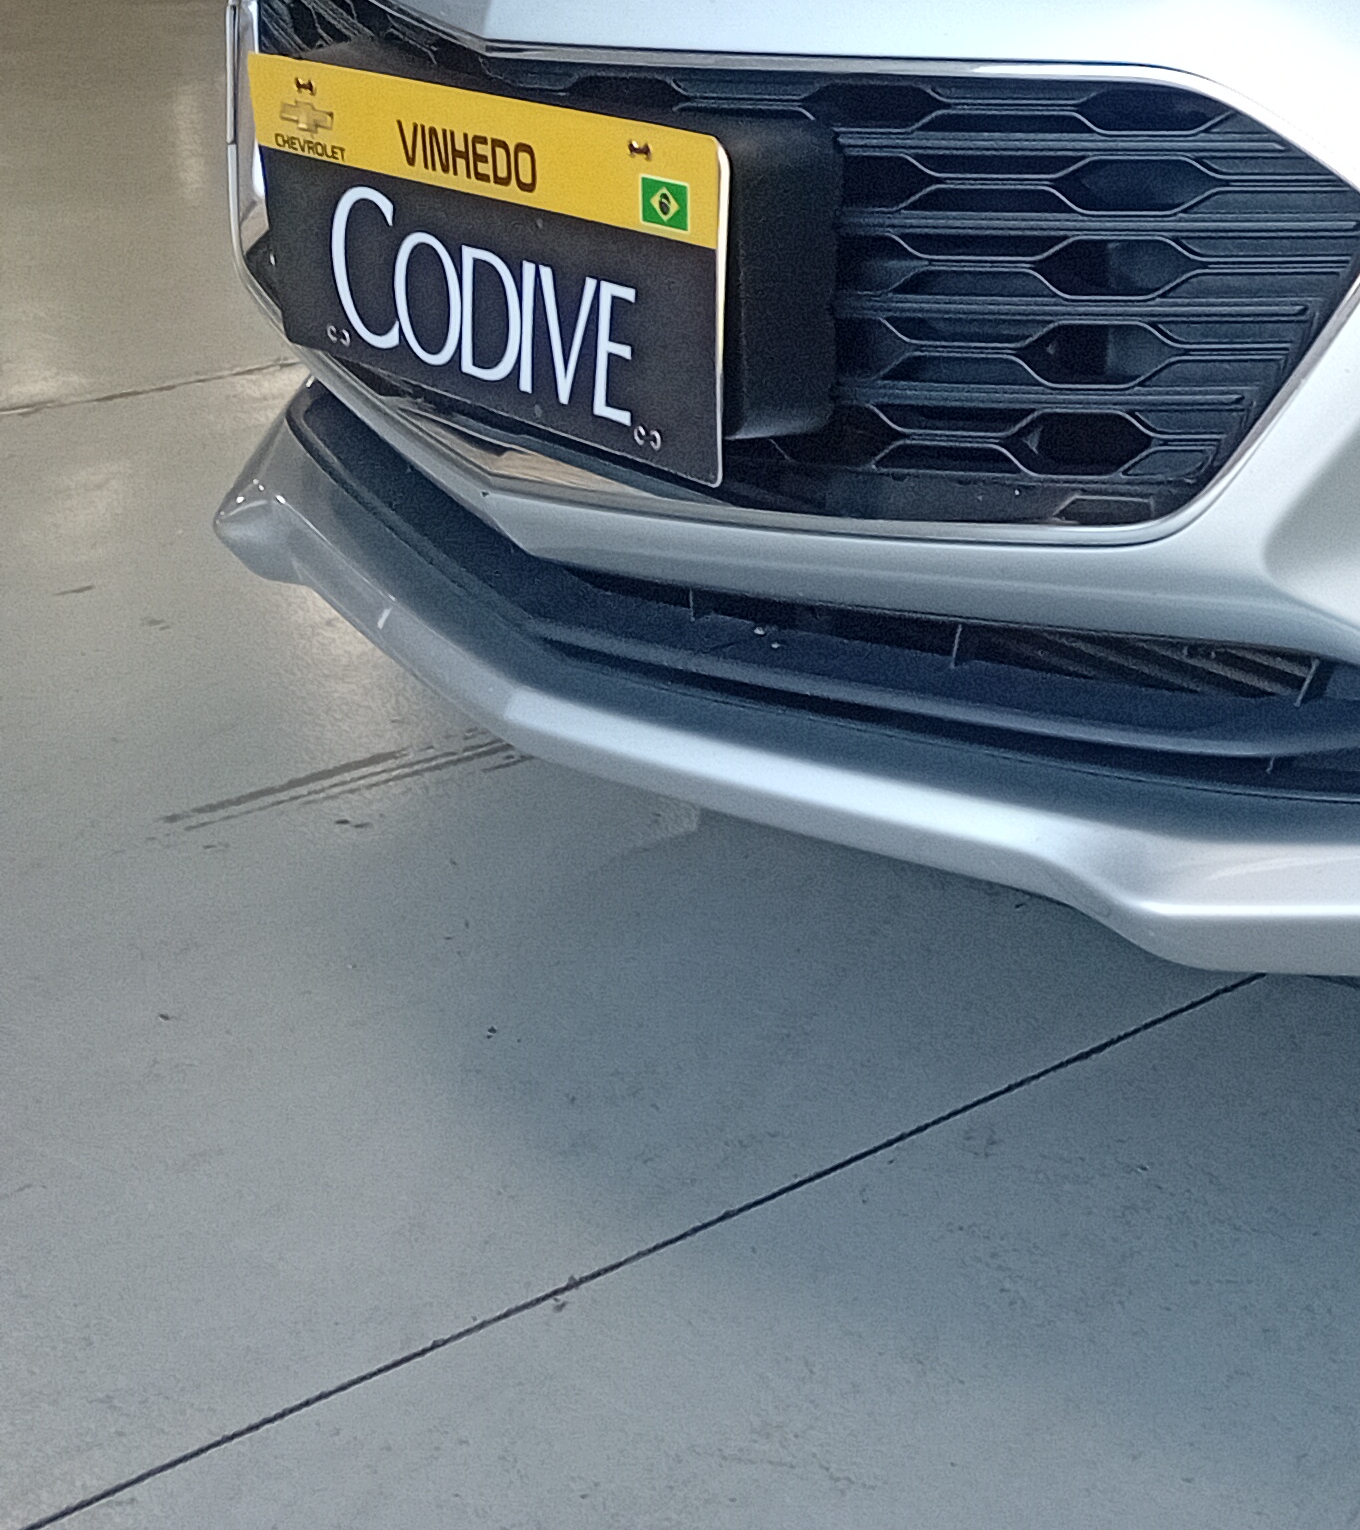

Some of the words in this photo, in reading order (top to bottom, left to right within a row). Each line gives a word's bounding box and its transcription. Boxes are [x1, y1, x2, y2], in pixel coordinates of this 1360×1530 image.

[274, 132, 347, 163] CHEVROLET
[396, 119, 538, 193] VINHEDO
[330, 185, 637, 427] CODIVE
